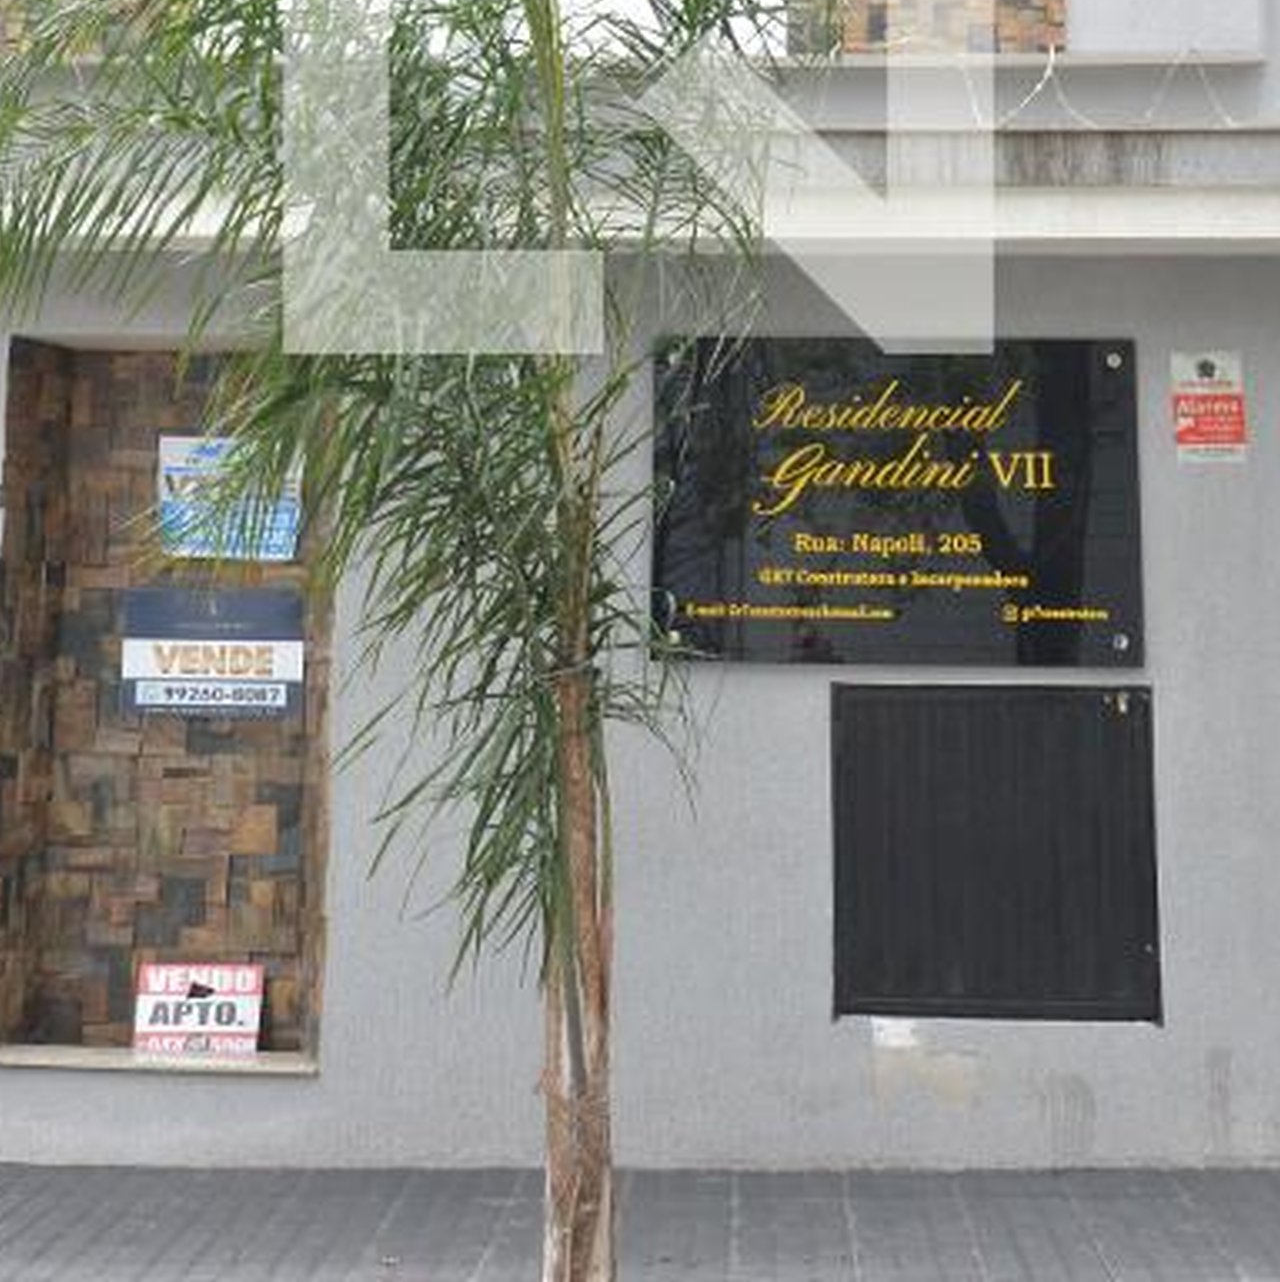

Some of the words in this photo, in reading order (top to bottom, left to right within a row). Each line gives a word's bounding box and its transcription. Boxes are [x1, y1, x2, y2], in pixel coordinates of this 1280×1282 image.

[753, 379, 1023, 430] Residencial
[752, 433, 980, 516] Gandini
[988, 451, 1057, 489] VII
[795, 533, 846, 553] Rua:
[938, 533, 983, 553] 205
[153, 643, 273, 675] VENDE
[148, 965, 258, 994] VENDO
[148, 1000, 245, 1026] APTO.
